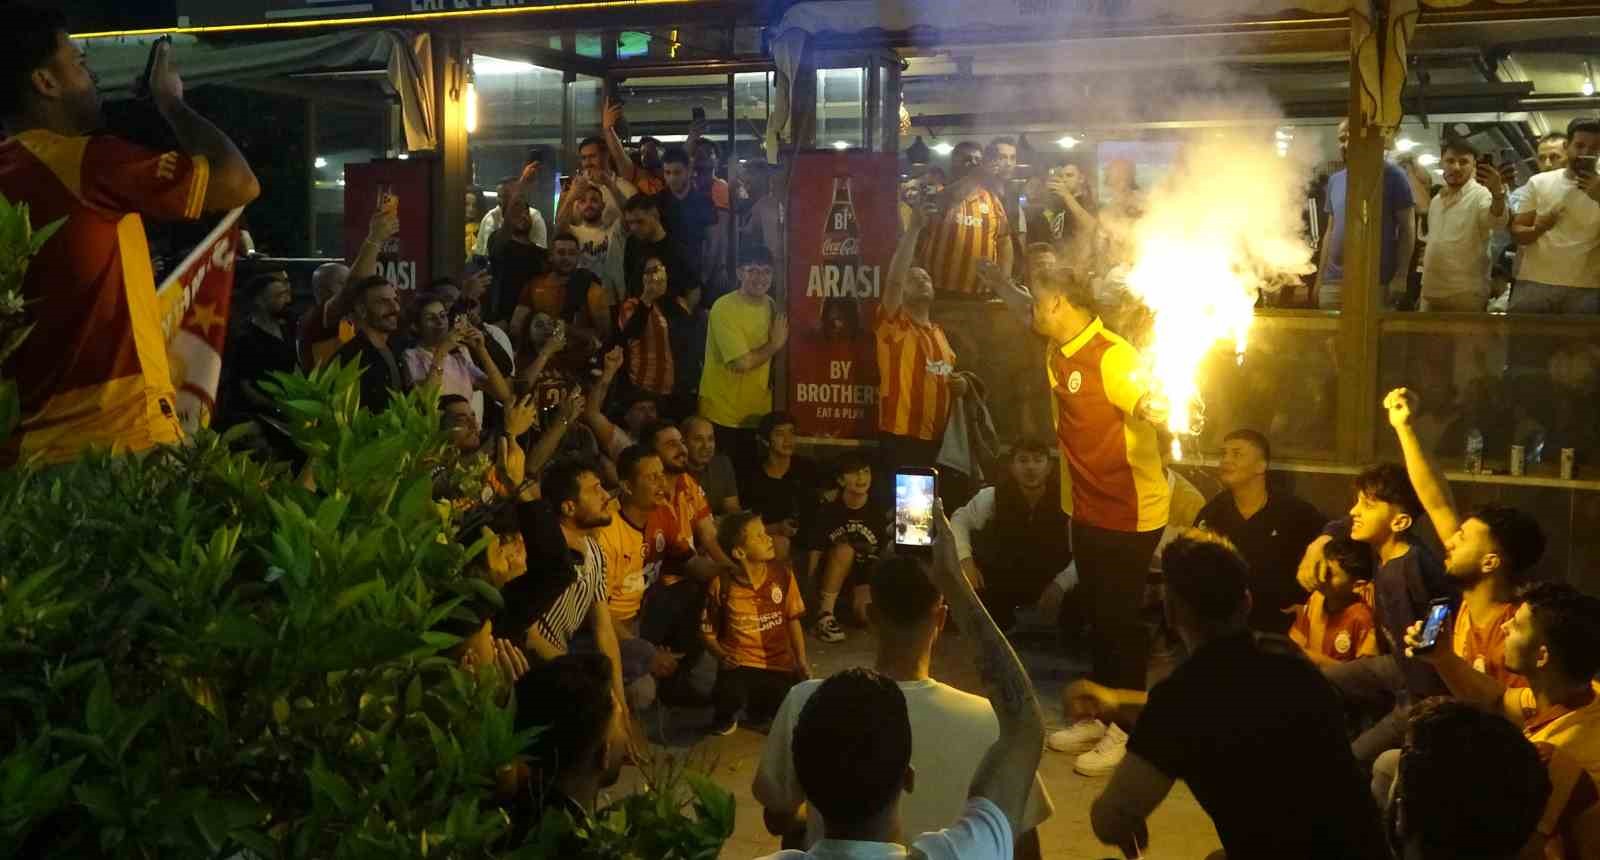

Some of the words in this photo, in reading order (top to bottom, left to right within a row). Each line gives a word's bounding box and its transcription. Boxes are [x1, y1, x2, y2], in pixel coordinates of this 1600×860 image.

[806, 265, 880, 298] ARASI
[830, 360, 852, 379] BY
[797, 383, 879, 404] BROTHER
[816, 407, 832, 418] EAT
